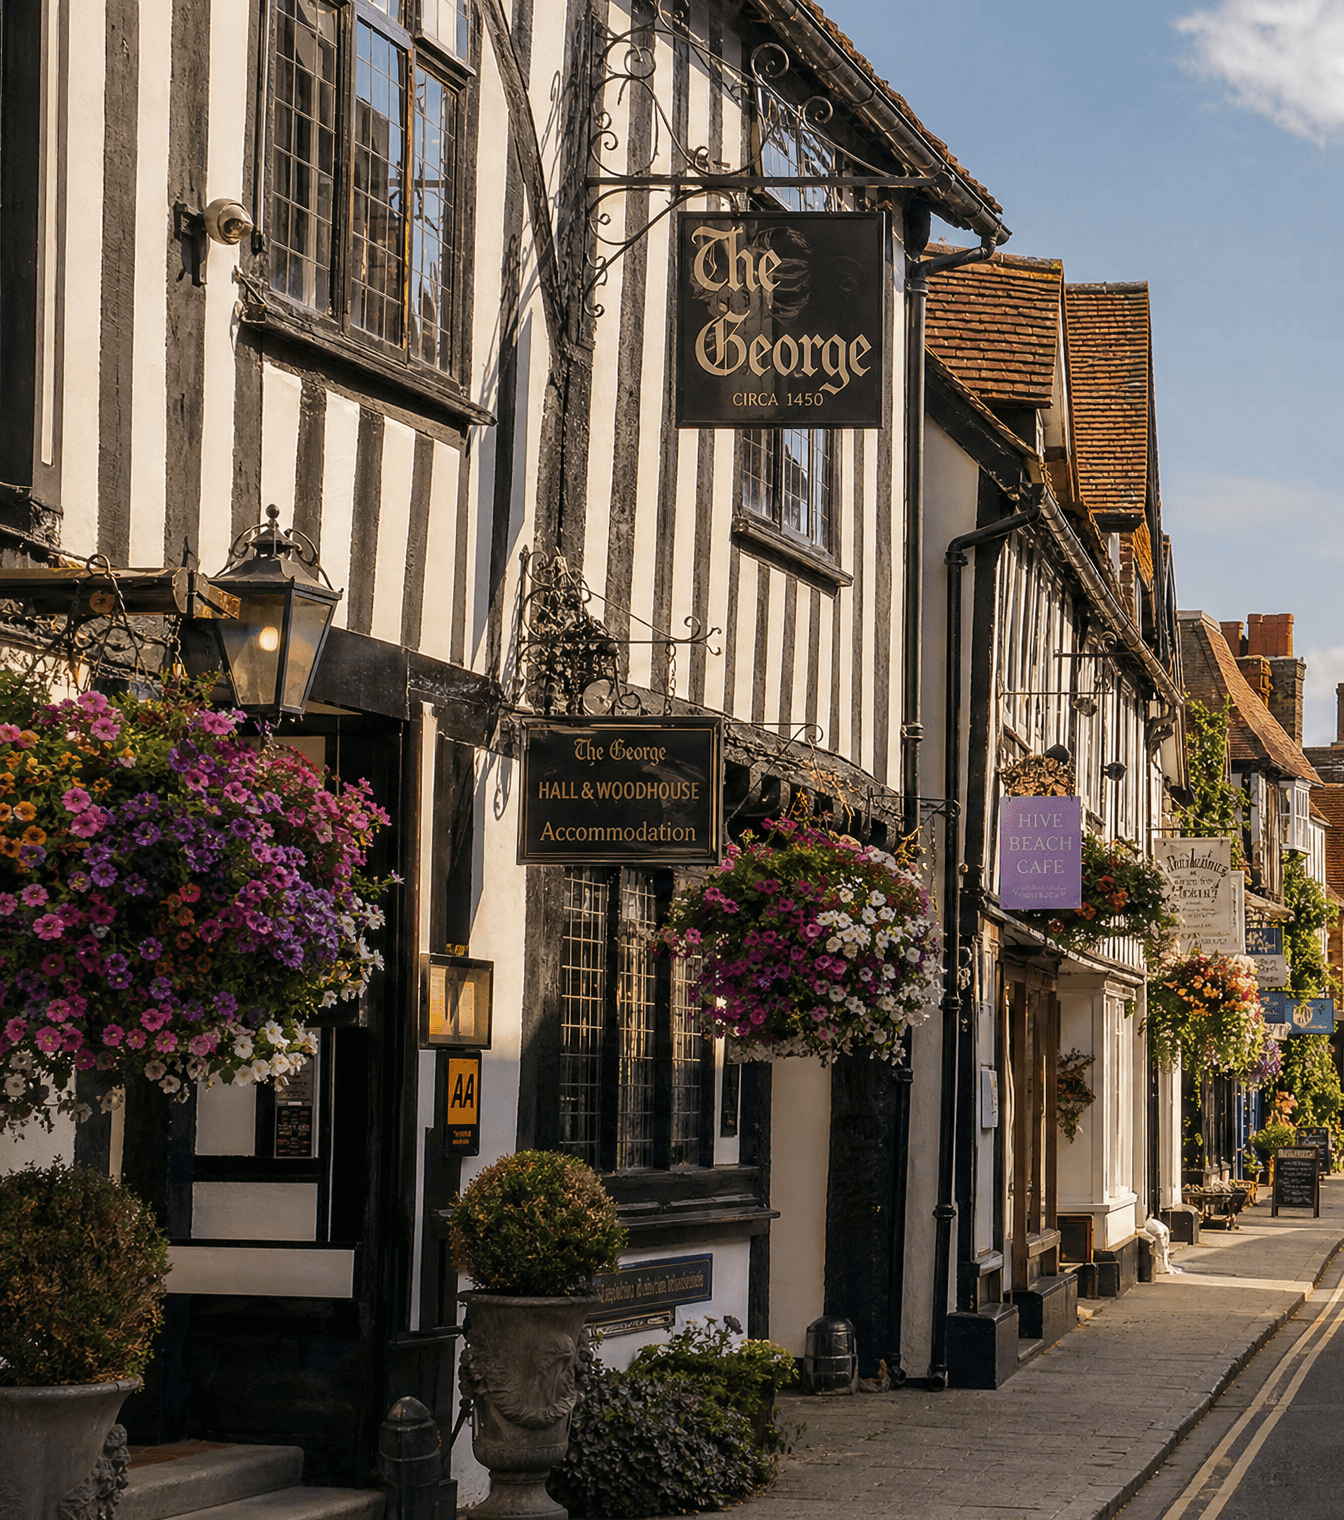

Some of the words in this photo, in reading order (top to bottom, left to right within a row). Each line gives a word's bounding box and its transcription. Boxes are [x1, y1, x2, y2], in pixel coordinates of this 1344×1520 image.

[691, 226, 782, 292] The
[695, 310, 872, 395] George
[733, 392, 779, 406] CIRCA
[786, 393, 824, 406] 1450
[574, 738, 604, 766] The
[609, 738, 667, 767] George
[538, 781, 578, 799] HALL
[581, 781, 594, 800] &
[596, 781, 700, 800] WOODHOUSE
[1018, 813, 1063, 828] HIVE
[540, 821, 697, 842] Accommodation
[1009, 836, 1072, 851] BEACH
[1017, 859, 1064, 874] CAFE
[450, 1073, 474, 1108] AA
